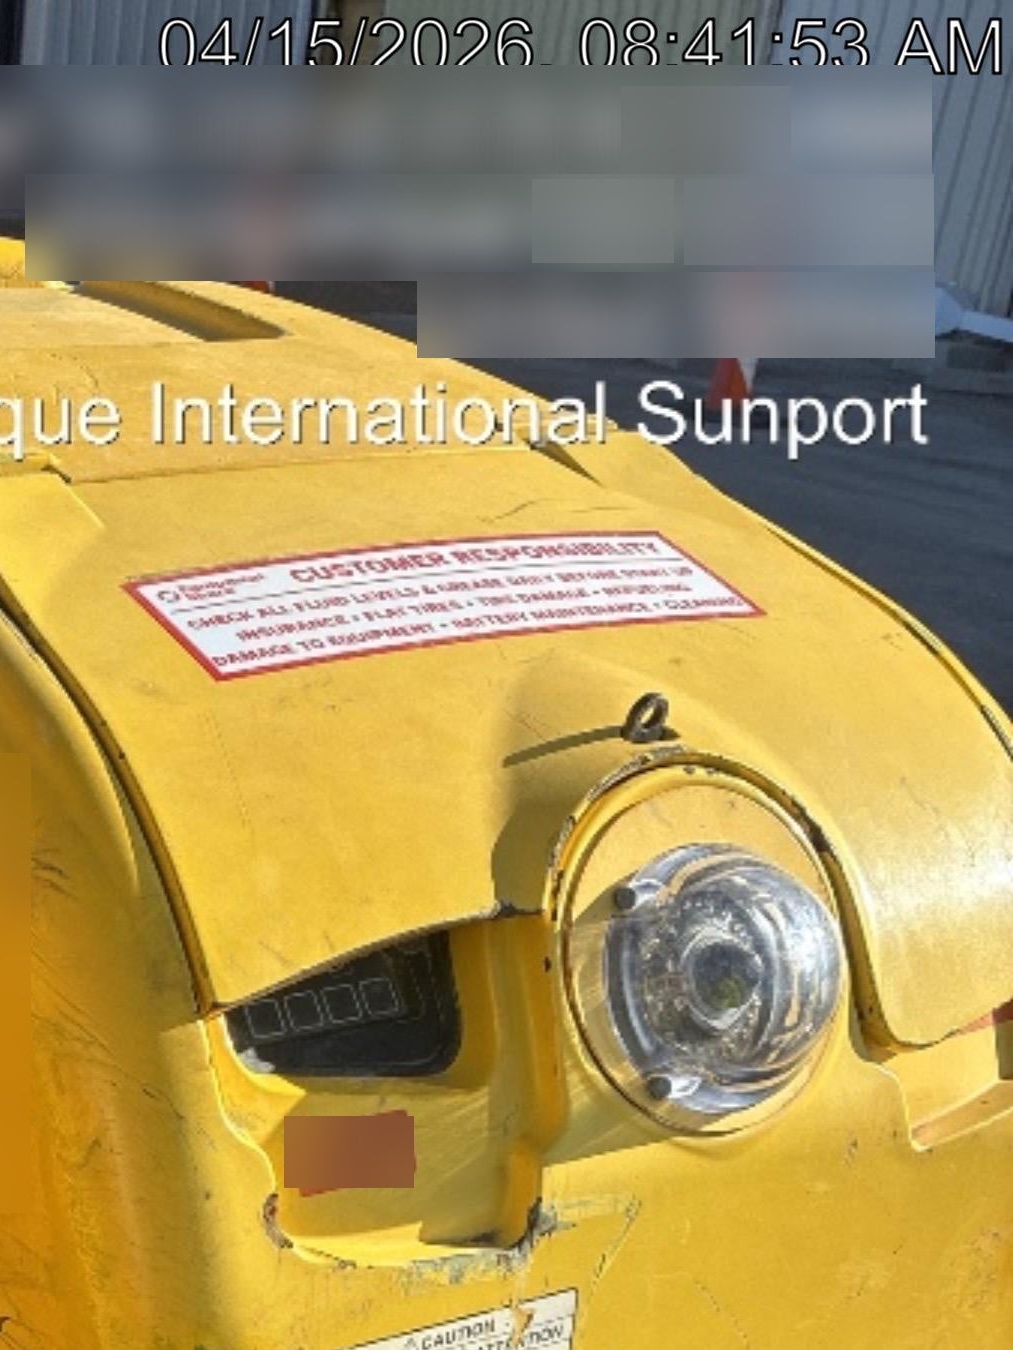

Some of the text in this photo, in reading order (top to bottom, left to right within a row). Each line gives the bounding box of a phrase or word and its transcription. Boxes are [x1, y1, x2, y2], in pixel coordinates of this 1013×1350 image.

[290, 542, 659, 582] CUSTOMER RESPONSIBILITY
[187, 609, 255, 630] CHECK
[256, 605, 291, 620] ALL
[291, 596, 351, 613] FLUID
[350, 587, 420, 604] LEVELS
[235, 614, 351, 642] INSURANCE
[211, 643, 299, 667] DAMAGE
[295, 637, 326, 652] TO
[326, 621, 436, 646] EQUIPMENT
[528, 600, 655, 621] MAINTENANCE
